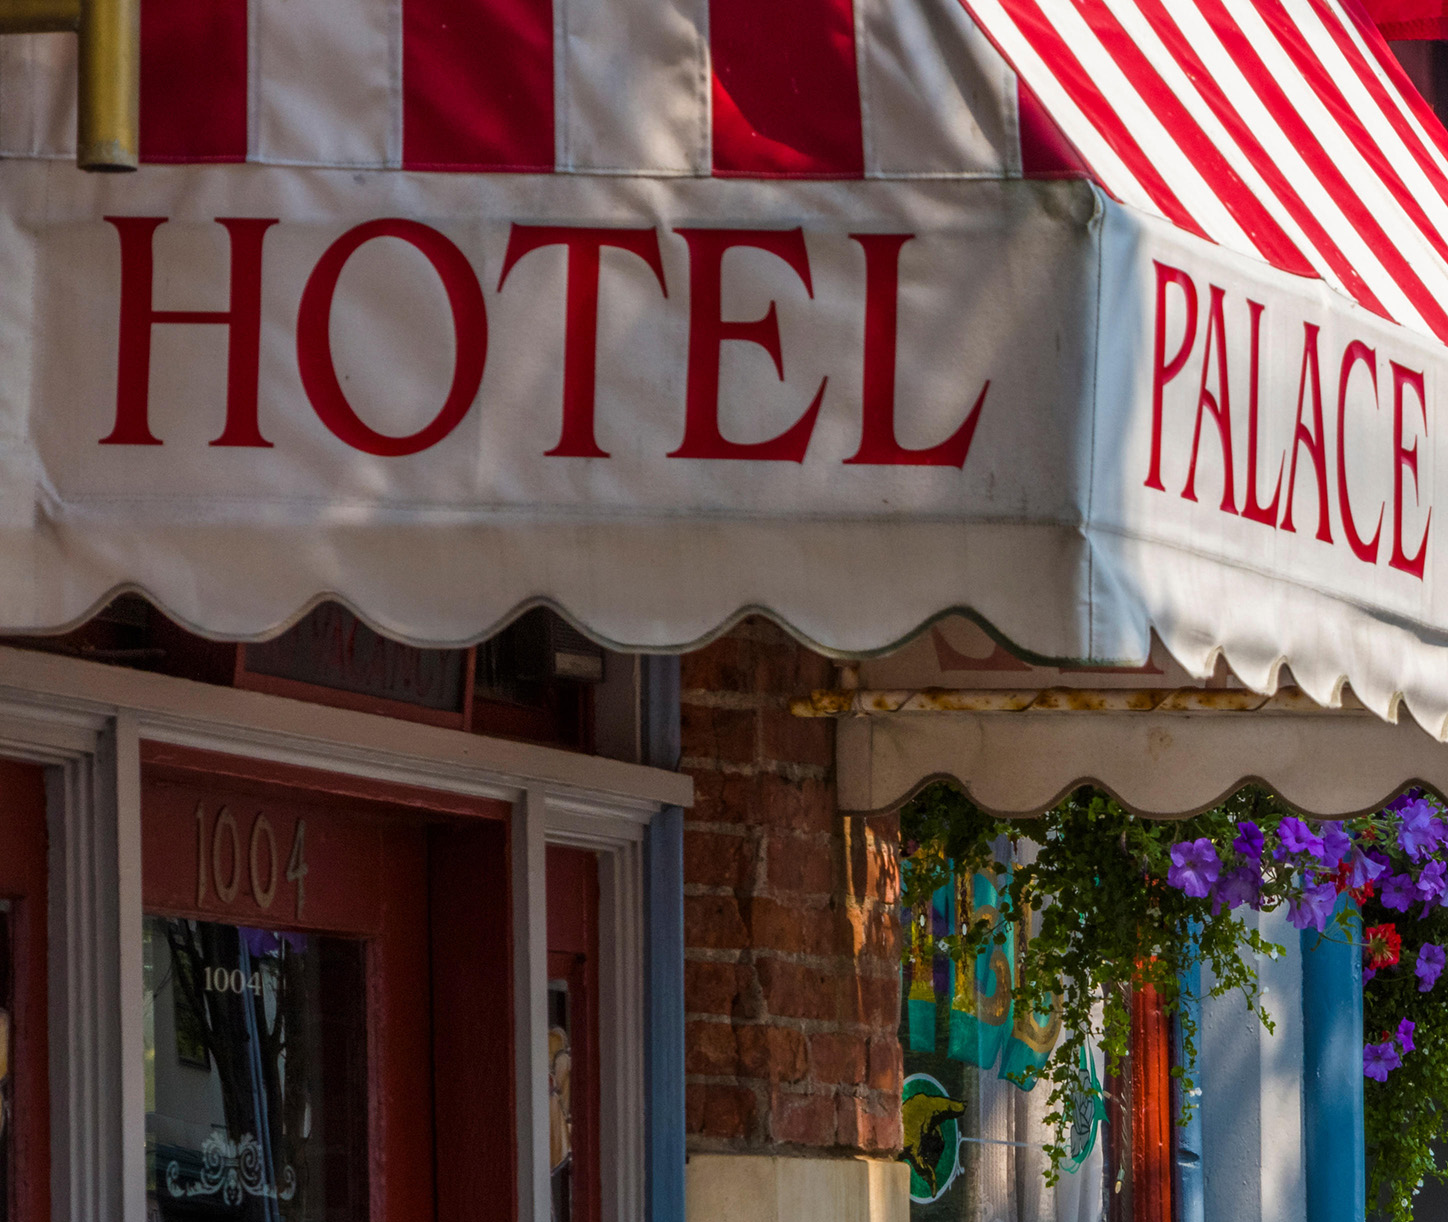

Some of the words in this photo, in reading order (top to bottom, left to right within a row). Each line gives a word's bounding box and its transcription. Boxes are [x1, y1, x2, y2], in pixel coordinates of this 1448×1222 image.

[98, 215, 991, 471] HOTEL
[1144, 258, 1433, 583] PALACE
[194, 799, 309, 921] 1004
[203, 966, 262, 996] 1004
